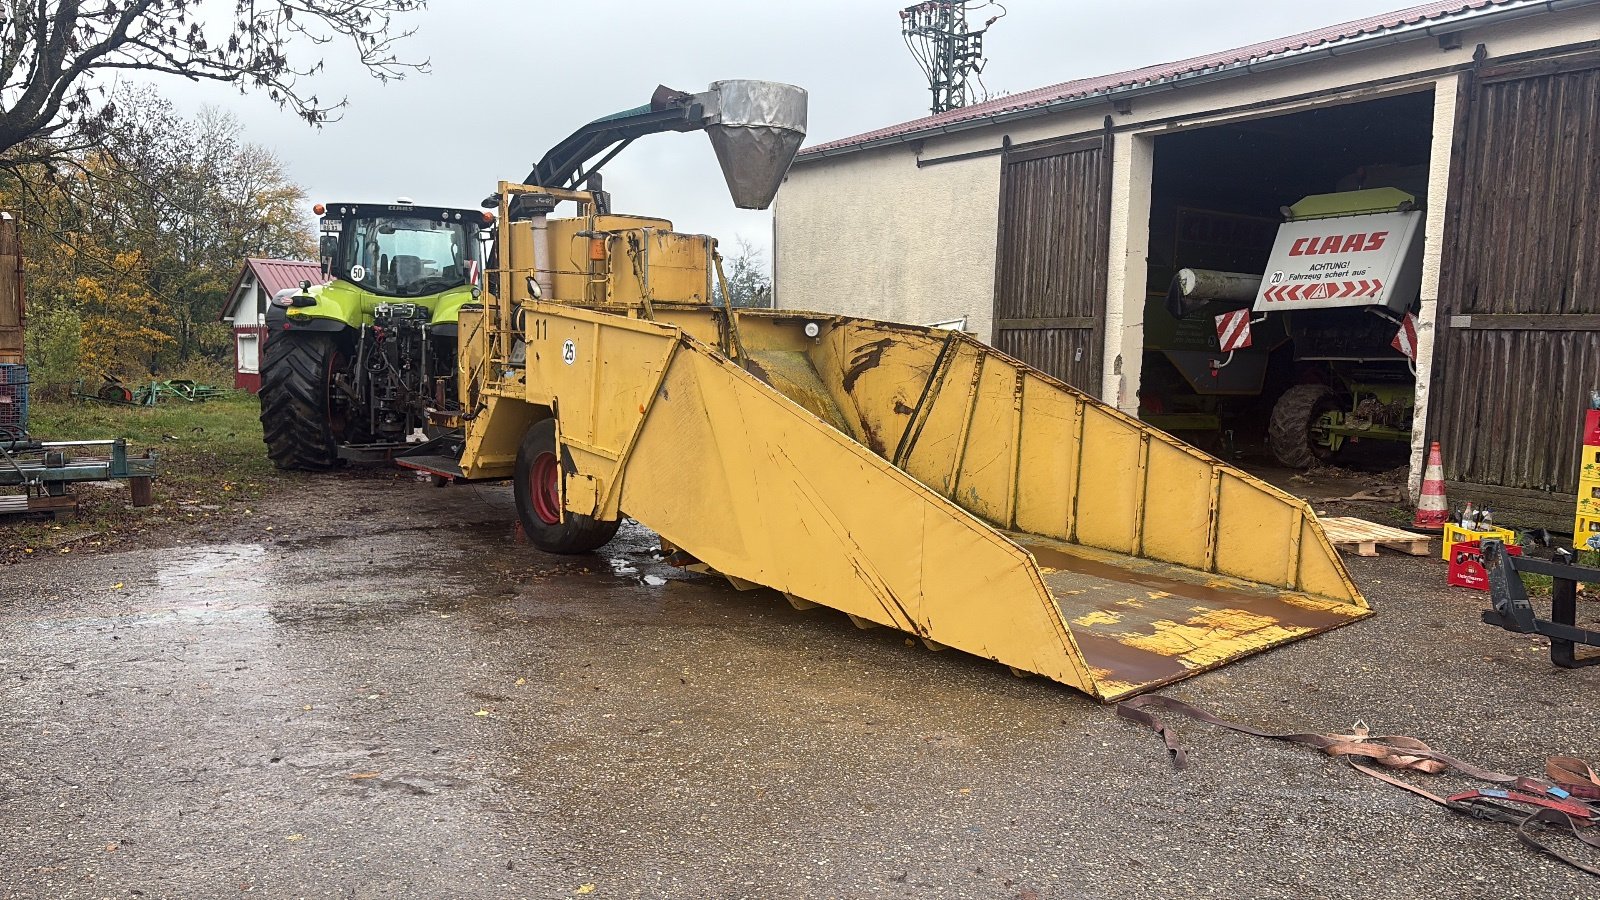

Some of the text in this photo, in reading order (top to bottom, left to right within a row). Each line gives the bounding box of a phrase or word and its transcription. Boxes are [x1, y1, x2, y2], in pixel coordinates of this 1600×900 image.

[1288, 230, 1389, 257] CLAAS
[1309, 261, 1351, 271] ACHTUNG!
[353, 267, 362, 279] 50
[1271, 272, 1283, 283] 20
[1288, 273, 1322, 281] Fahrzeug
[1325, 271, 1349, 279] schert
[536, 319, 546, 340] 11
[565, 343, 574, 360] 25
